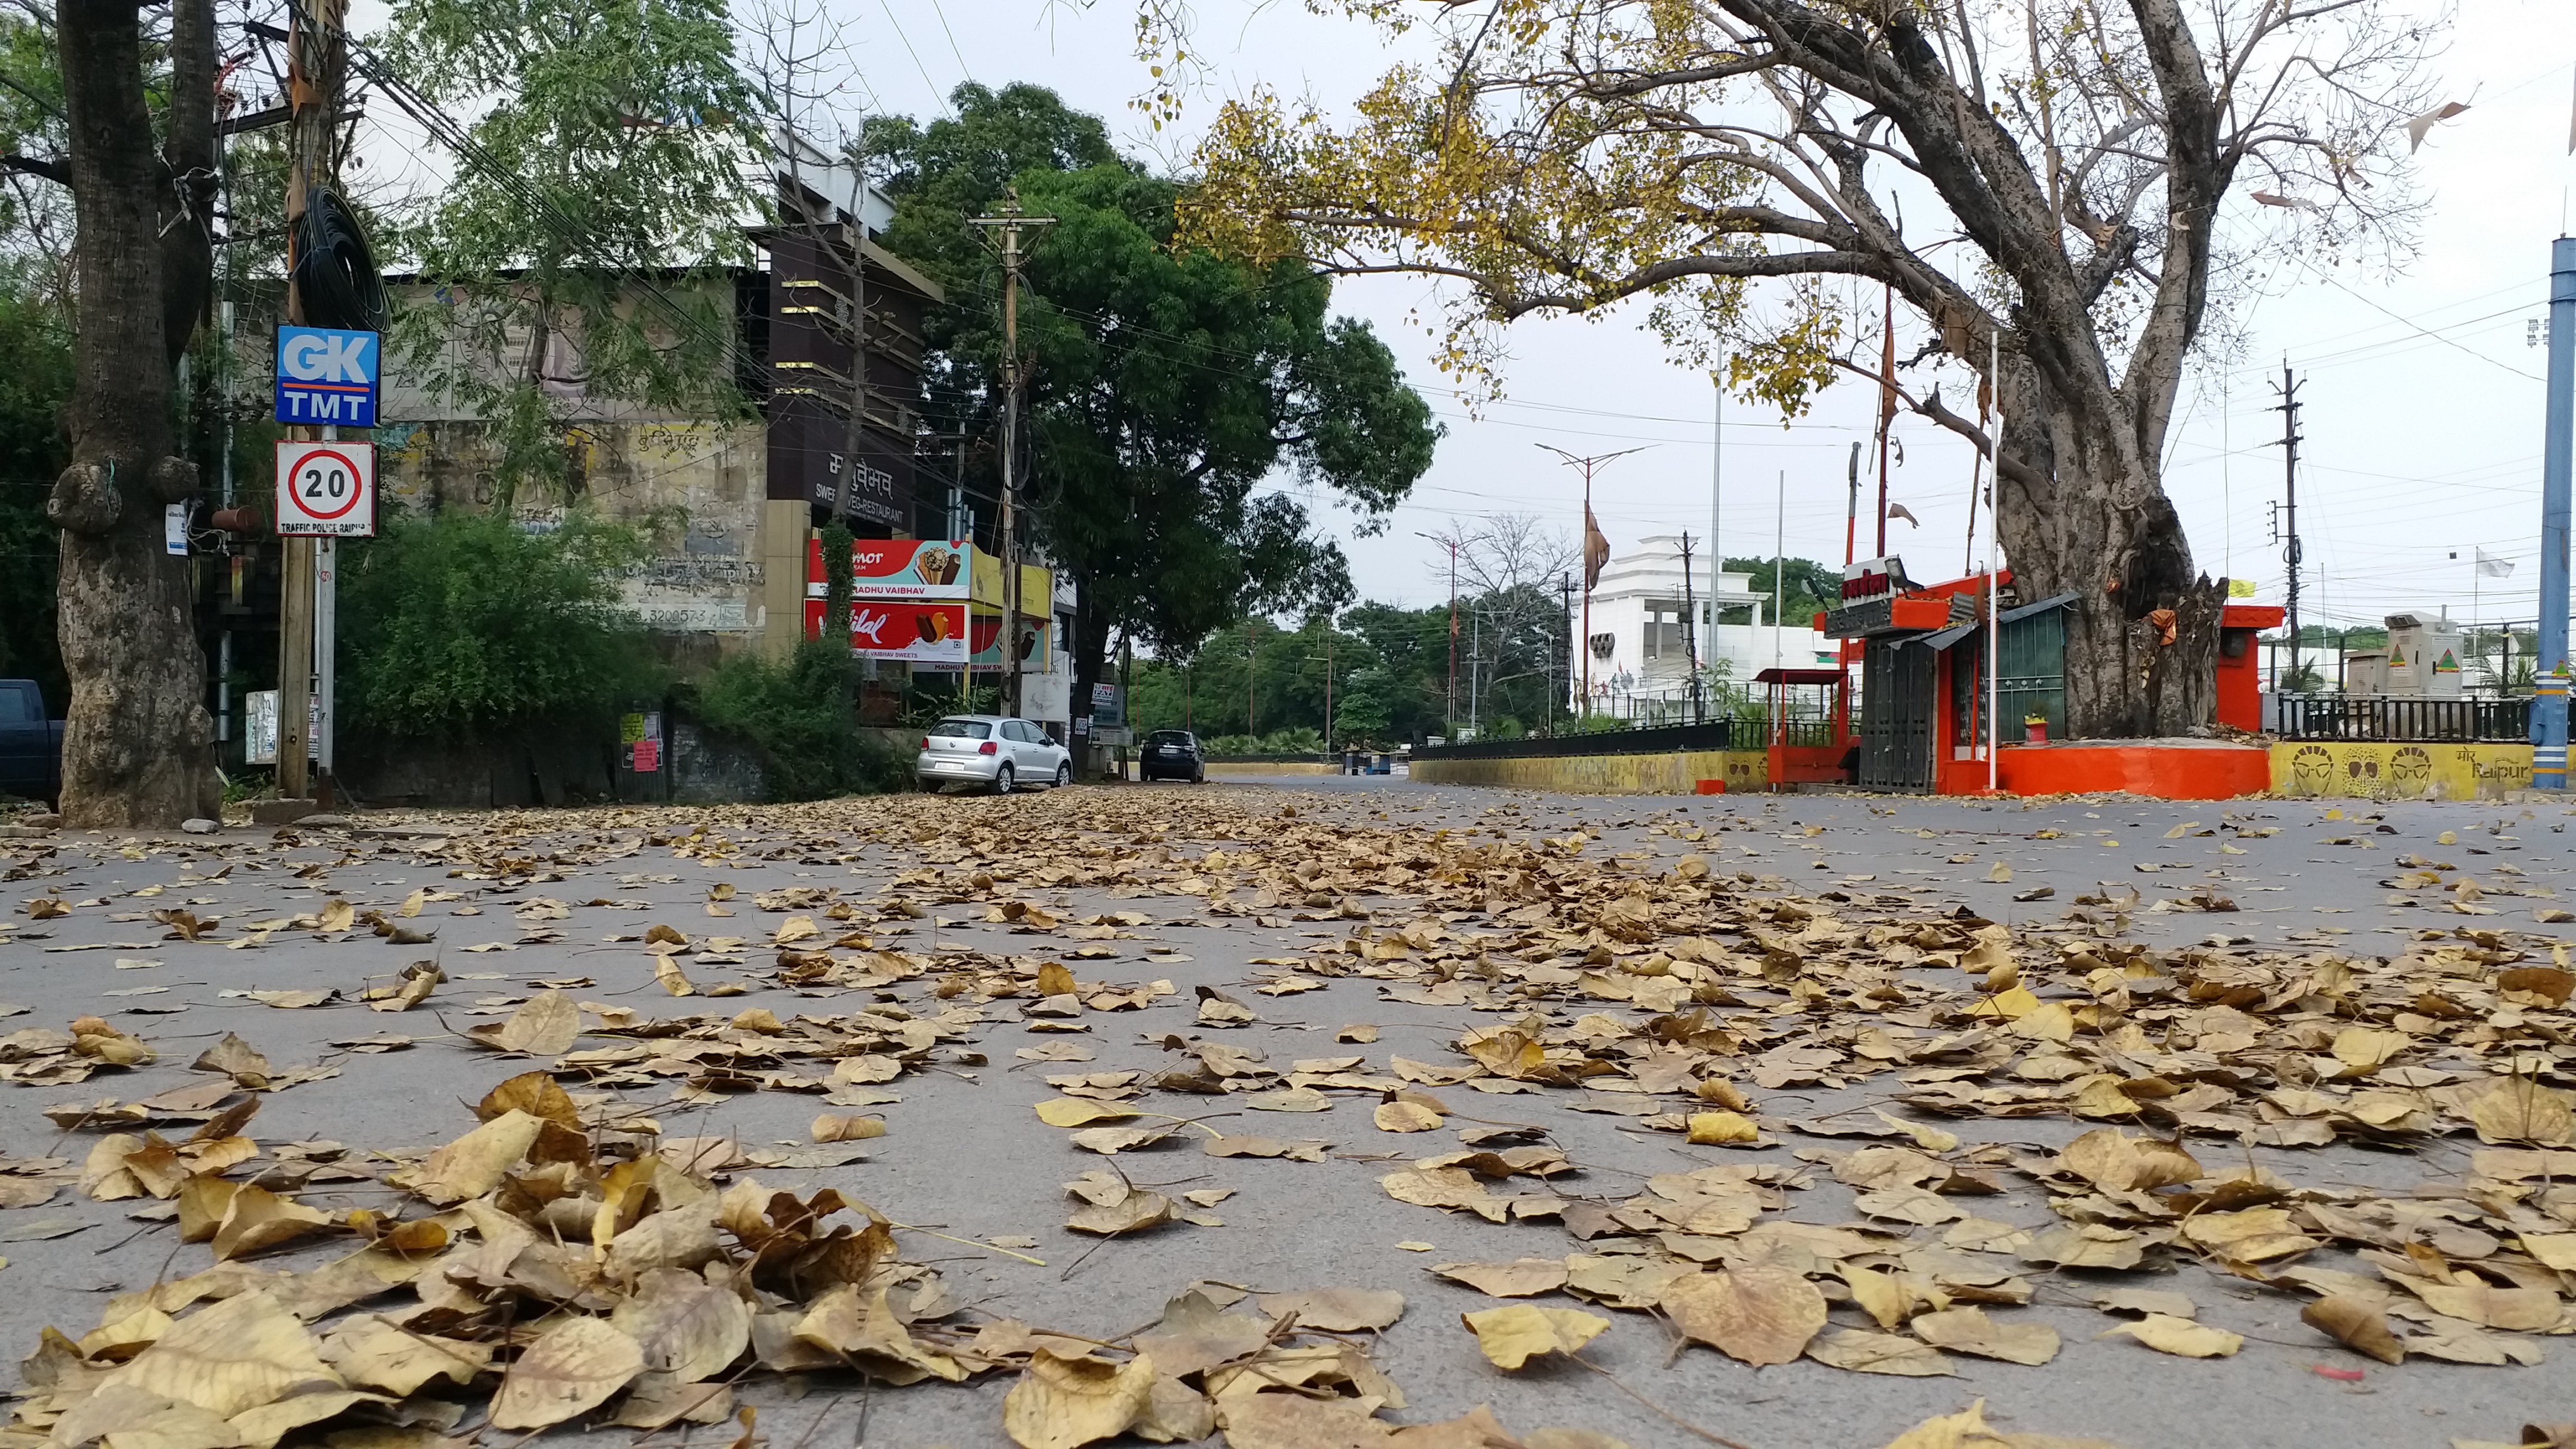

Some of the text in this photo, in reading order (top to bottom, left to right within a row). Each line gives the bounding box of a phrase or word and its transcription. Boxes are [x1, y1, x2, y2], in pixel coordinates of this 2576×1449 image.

[283, 335, 369, 383] GK
[285, 391, 367, 420] TMT
[305, 469, 345, 498] 20
[281, 523, 310, 533] TRAFFIC
[2456, 746, 2476, 763] मोर
